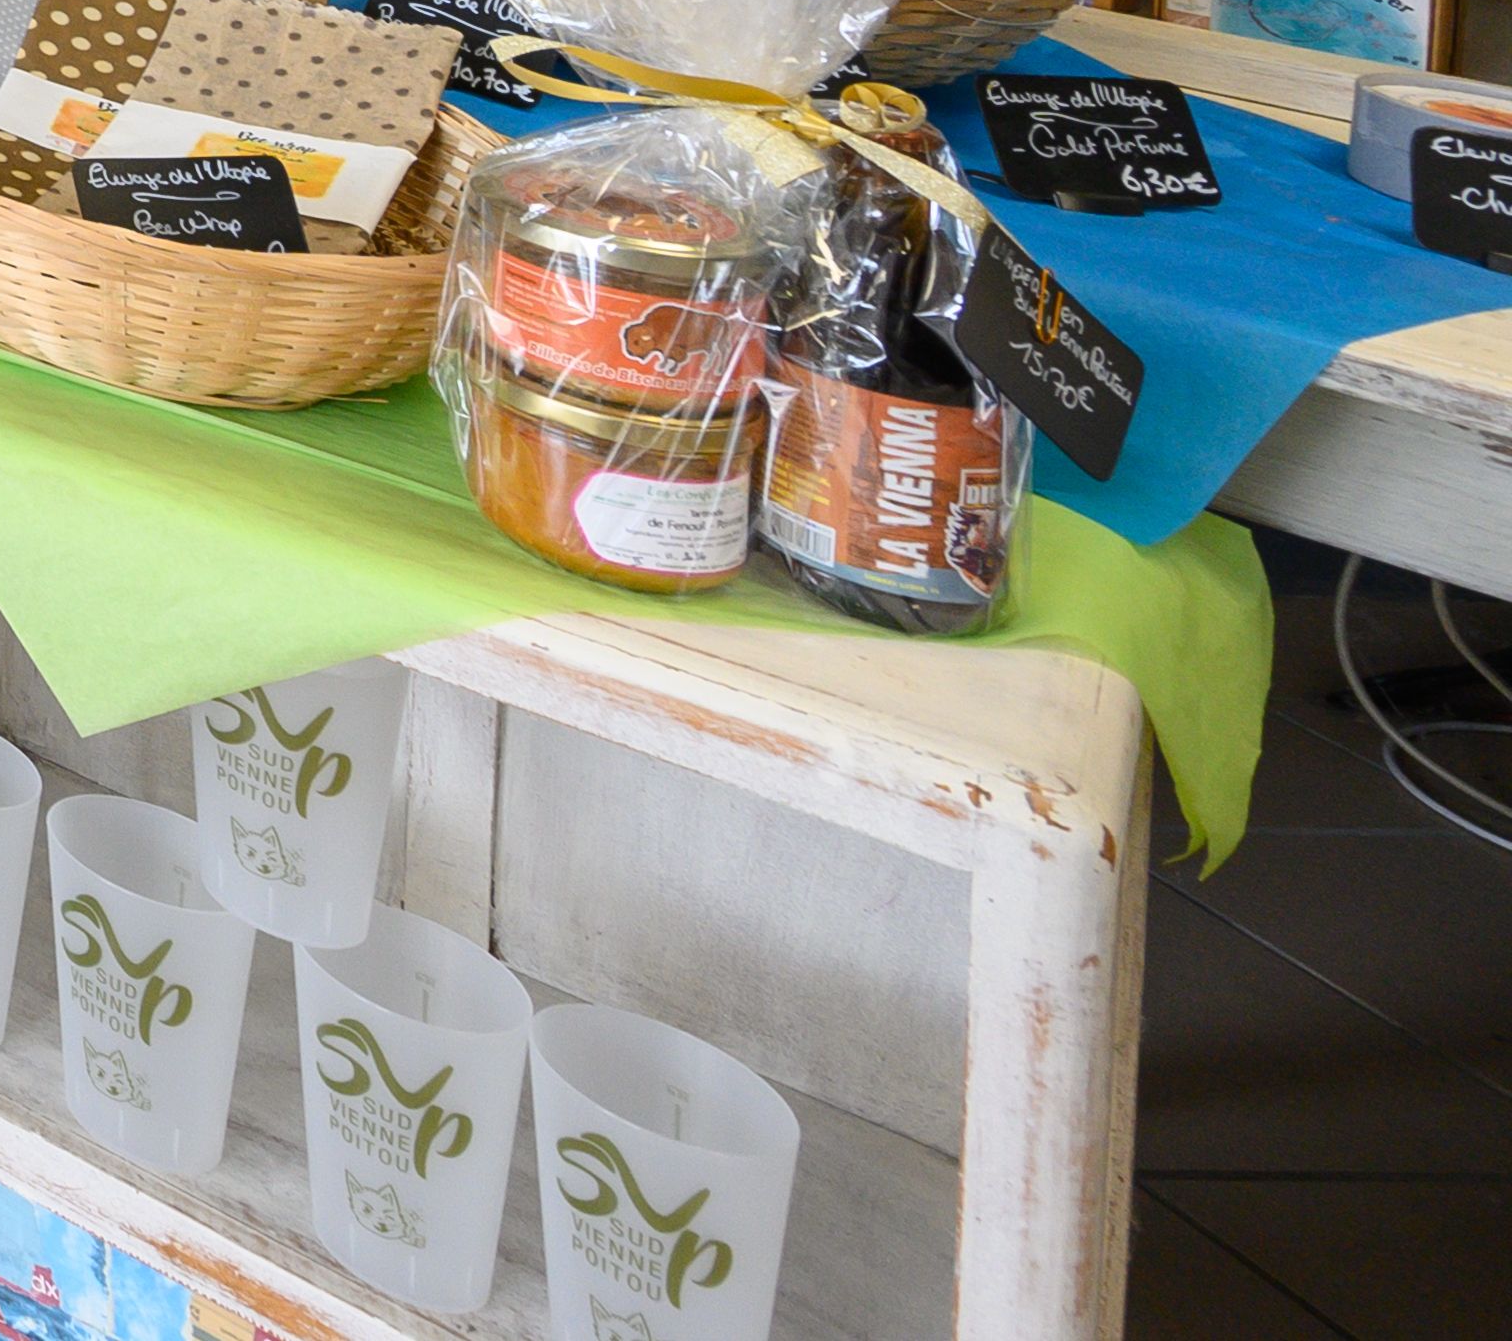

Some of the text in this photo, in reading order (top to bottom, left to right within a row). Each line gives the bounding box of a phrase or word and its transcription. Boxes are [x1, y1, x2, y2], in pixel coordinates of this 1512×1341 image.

[1120, 164, 1219, 197] 6,30€
[133, 210, 243, 240] Bee Wrap
[526, 342, 662, 388] Rillettes de Bison
[873, 405, 939, 580] LA VIENNA
[217, 744, 293, 793] VIENNE
[248, 743, 295, 772] SUD
[217, 767, 292, 814] POITOU
[72, 966, 136, 1020] VIENNE
[96, 967, 137, 1000] SUD
[71, 988, 136, 1041] POITOU
[330, 1093, 411, 1152] VIENNE
[363, 1097, 412, 1131] SUD
[330, 1115, 410, 1173] POITOU
